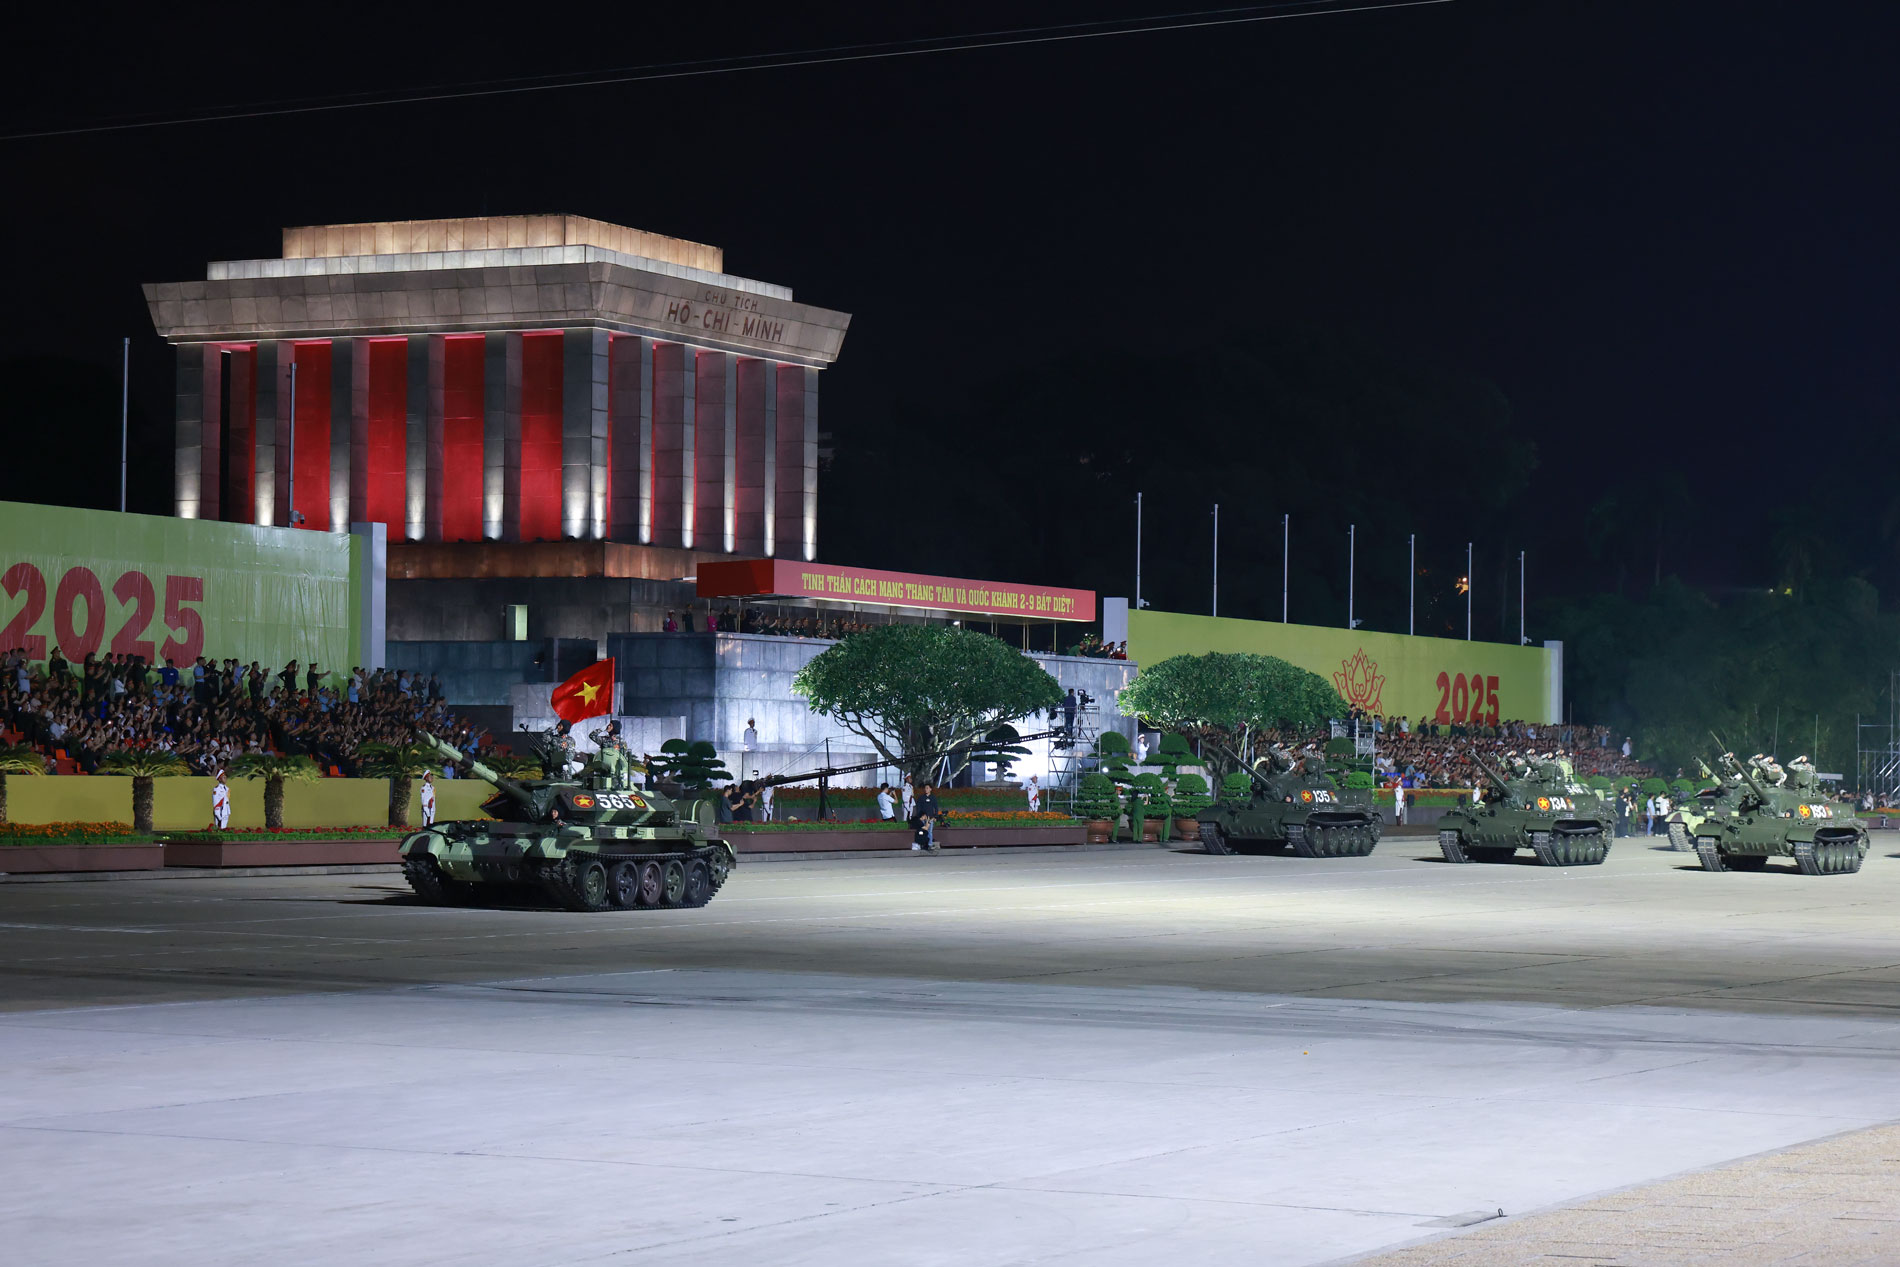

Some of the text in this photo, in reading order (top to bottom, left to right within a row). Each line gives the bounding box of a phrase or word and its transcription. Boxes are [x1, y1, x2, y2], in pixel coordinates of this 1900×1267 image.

[854, 575, 877, 596] CÁCH
[879, 580, 904, 600] MẠNG
[905, 580, 934, 601] THÁNG
[935, 583, 954, 603] TÁM
[956, 585, 967, 604] VÀ
[968, 585, 989, 606] QUỐC
[991, 588, 1018, 609] KHÁNH
[1020, 593, 1035, 610] 2-9
[1036, 591, 1052, 611] BẤT
[0, 562, 205, 669] 2025
[1435, 671, 1500, 728] 2025
[595, 793, 636, 810] 565
[1312, 789, 1330, 803] 135
[1549, 796, 1567, 810] 134
[1809, 804, 1827, 818] 193
